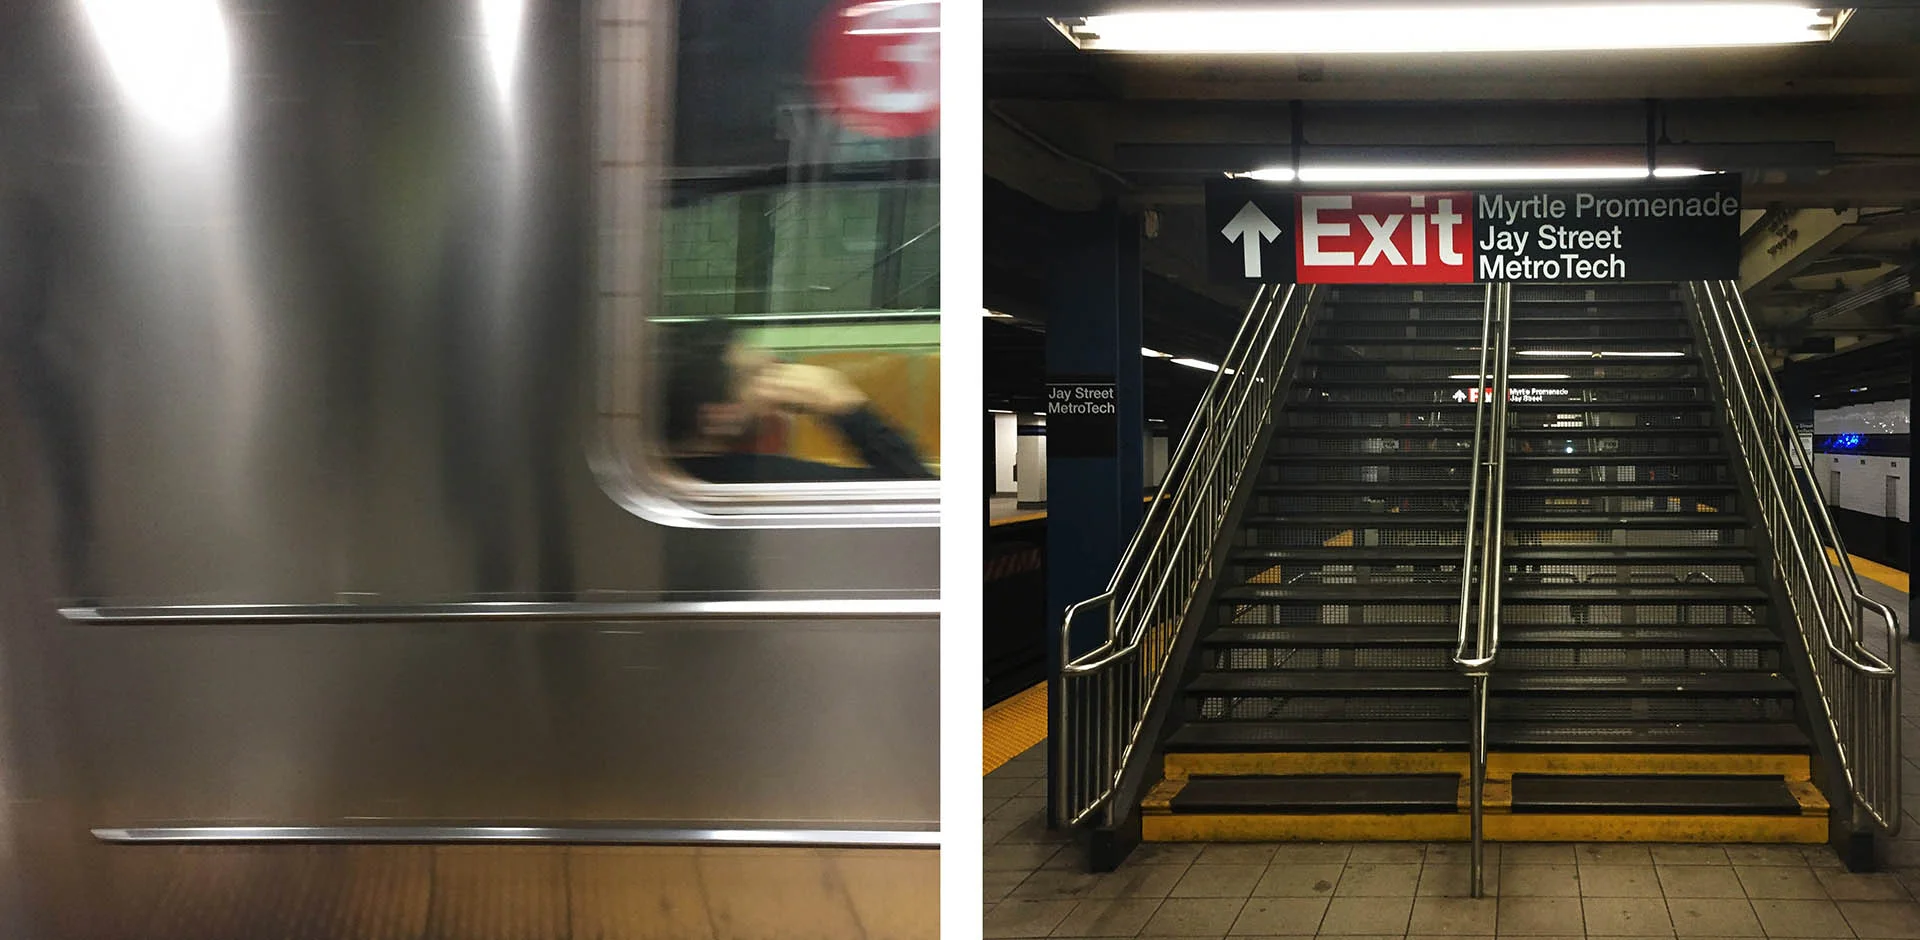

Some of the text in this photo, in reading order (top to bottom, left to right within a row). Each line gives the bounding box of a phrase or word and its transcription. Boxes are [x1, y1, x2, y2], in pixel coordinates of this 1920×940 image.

[840, 4, 940, 112] 3
[1478, 192, 1739, 225] Myrtle Promenade
[1301, 195, 1464, 266] Exit
[1479, 224, 1622, 256] Jay Street
[1479, 253, 1626, 280] MetroTech
[1048, 387, 1114, 402] Jay Street
[1048, 401, 1115, 414] MetroTech
